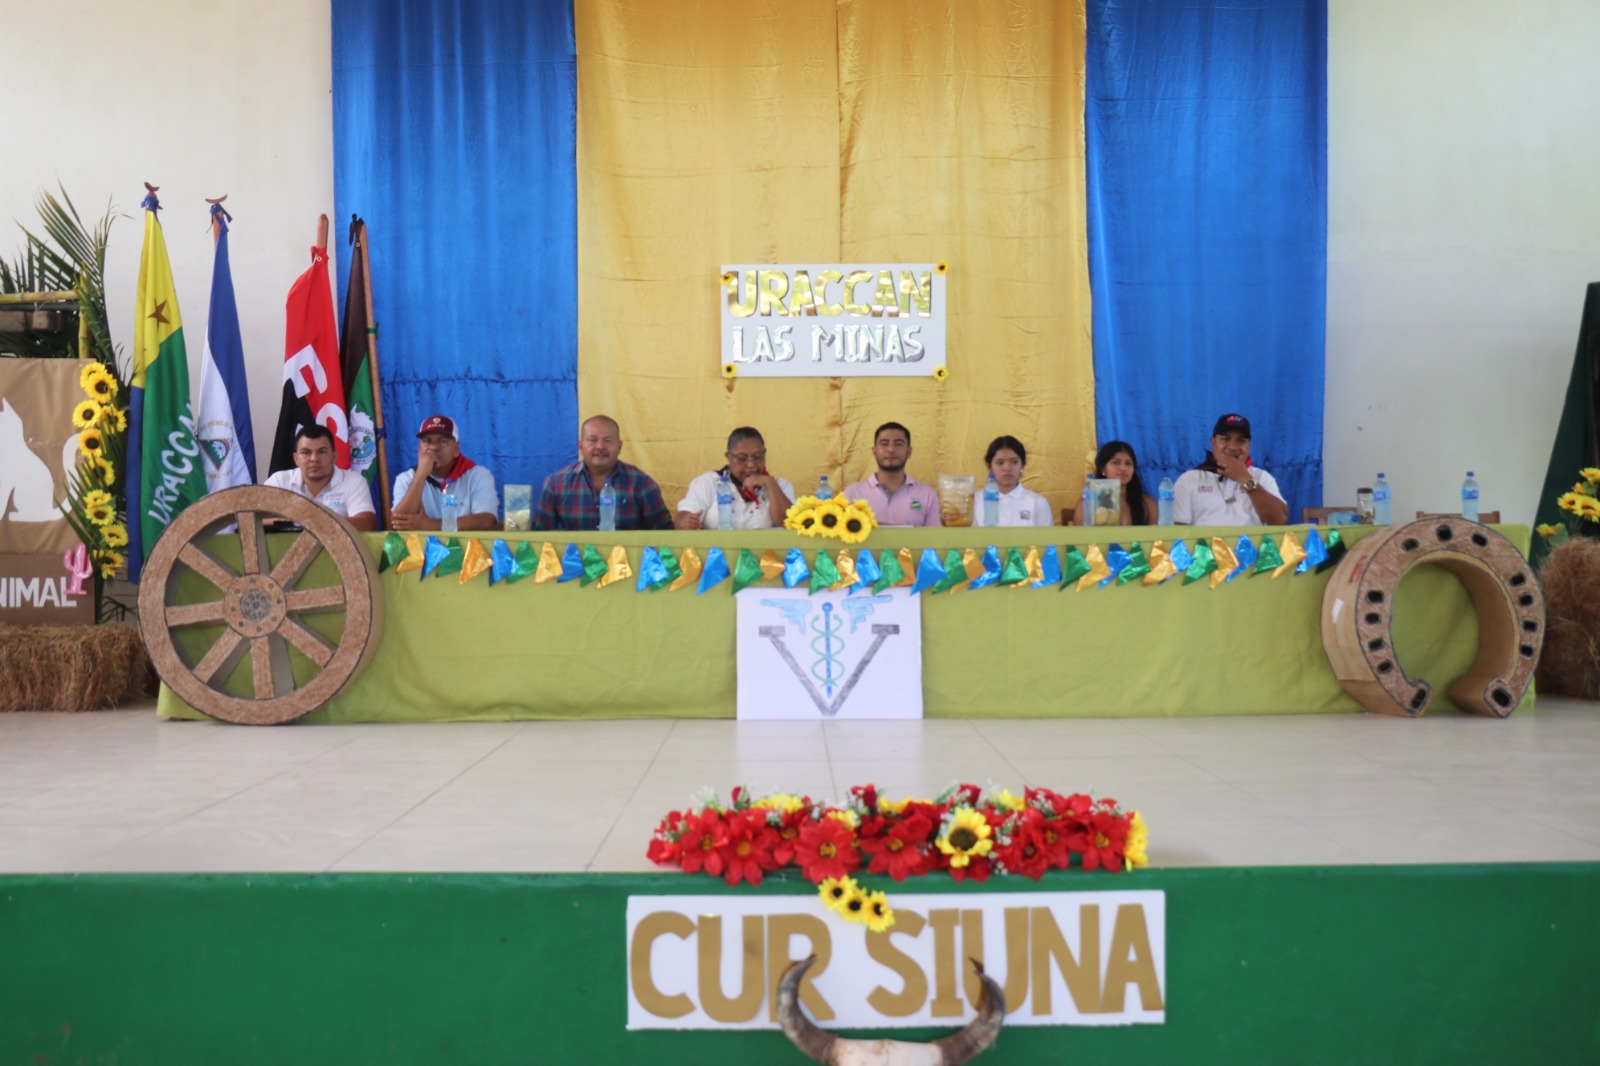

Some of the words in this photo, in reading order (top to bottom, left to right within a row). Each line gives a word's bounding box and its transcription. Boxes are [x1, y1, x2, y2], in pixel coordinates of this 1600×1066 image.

[727, 269, 932, 318] URACCAN
[733, 325, 795, 364] LAS
[811, 324, 925, 363] MINAS
[630, 909, 836, 1023] CUR
[865, 903, 1165, 1018] SIUNA
